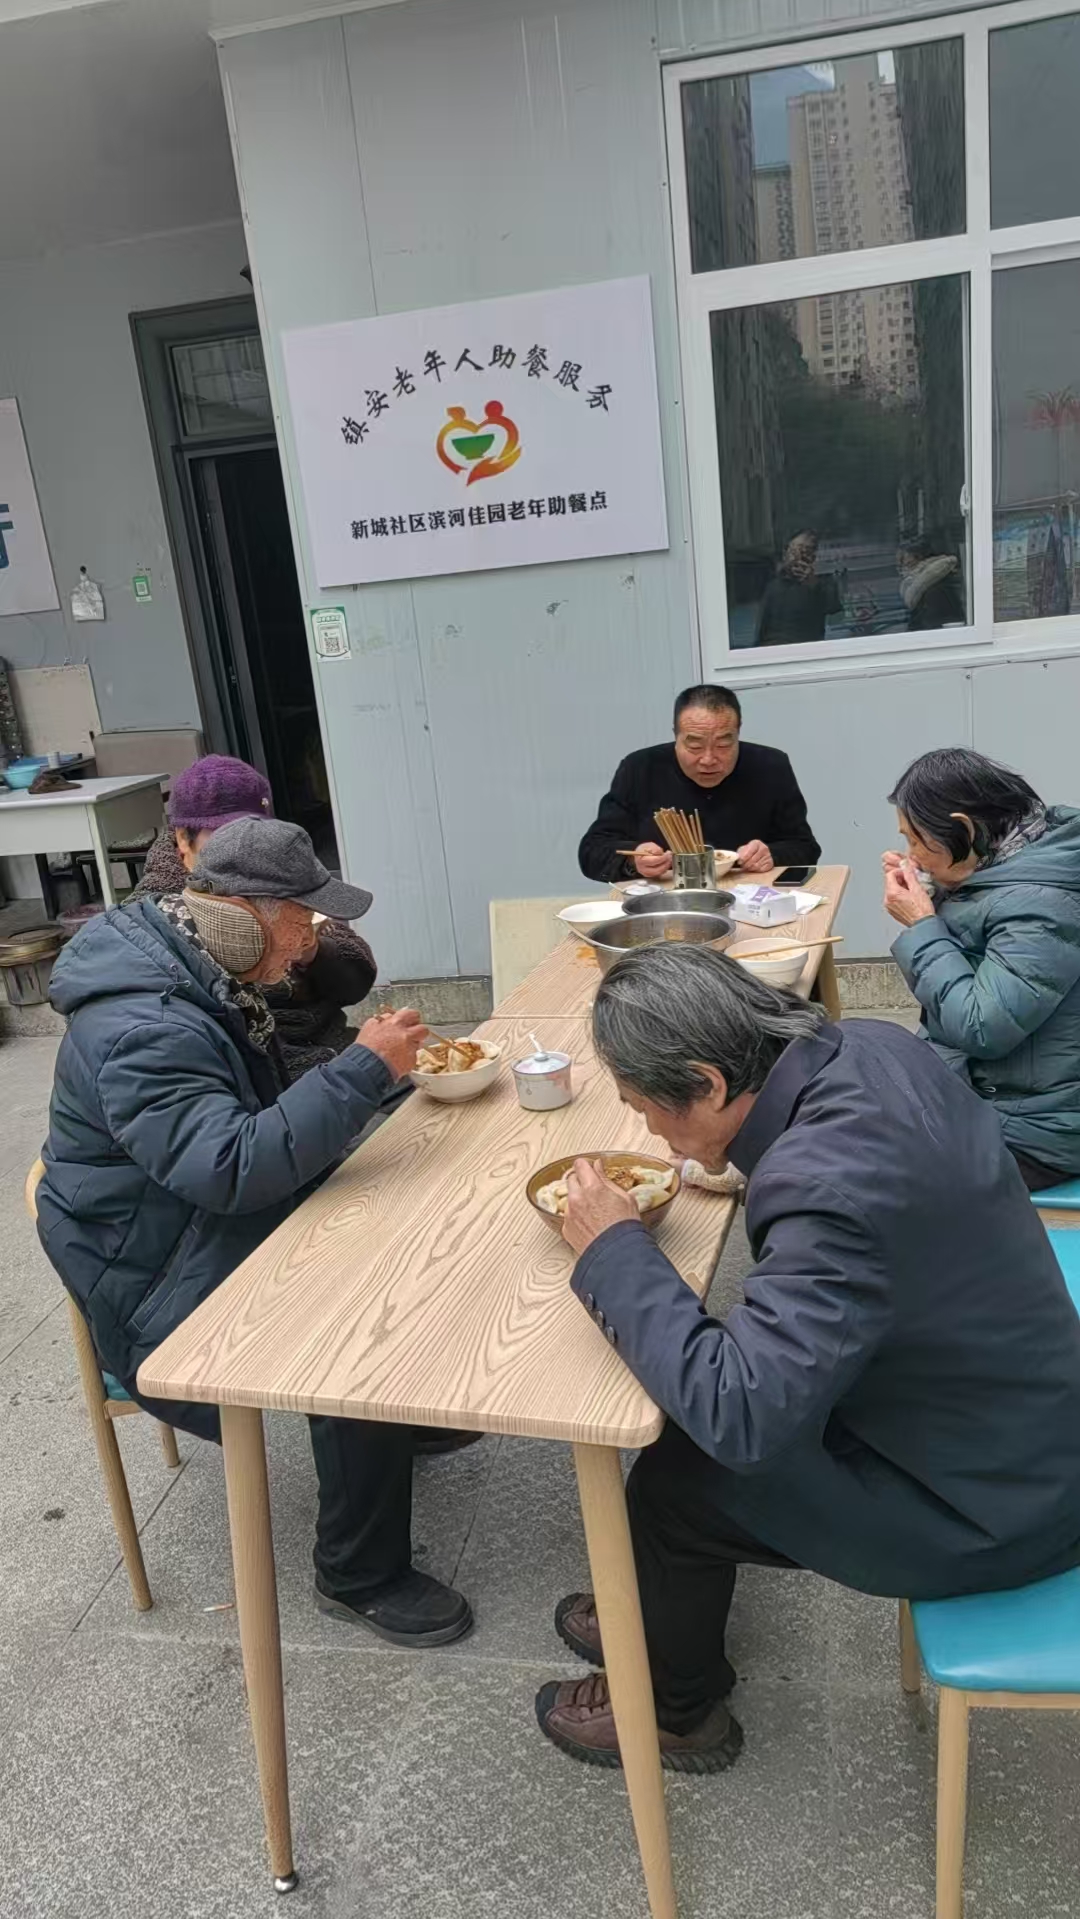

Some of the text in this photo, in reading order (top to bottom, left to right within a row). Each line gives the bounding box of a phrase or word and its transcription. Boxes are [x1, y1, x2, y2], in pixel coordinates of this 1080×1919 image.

[341, 344, 612, 444] 镇安老年人助餐服务
[351, 490, 607, 539] 新城社区滨河佳园老年助餐点
